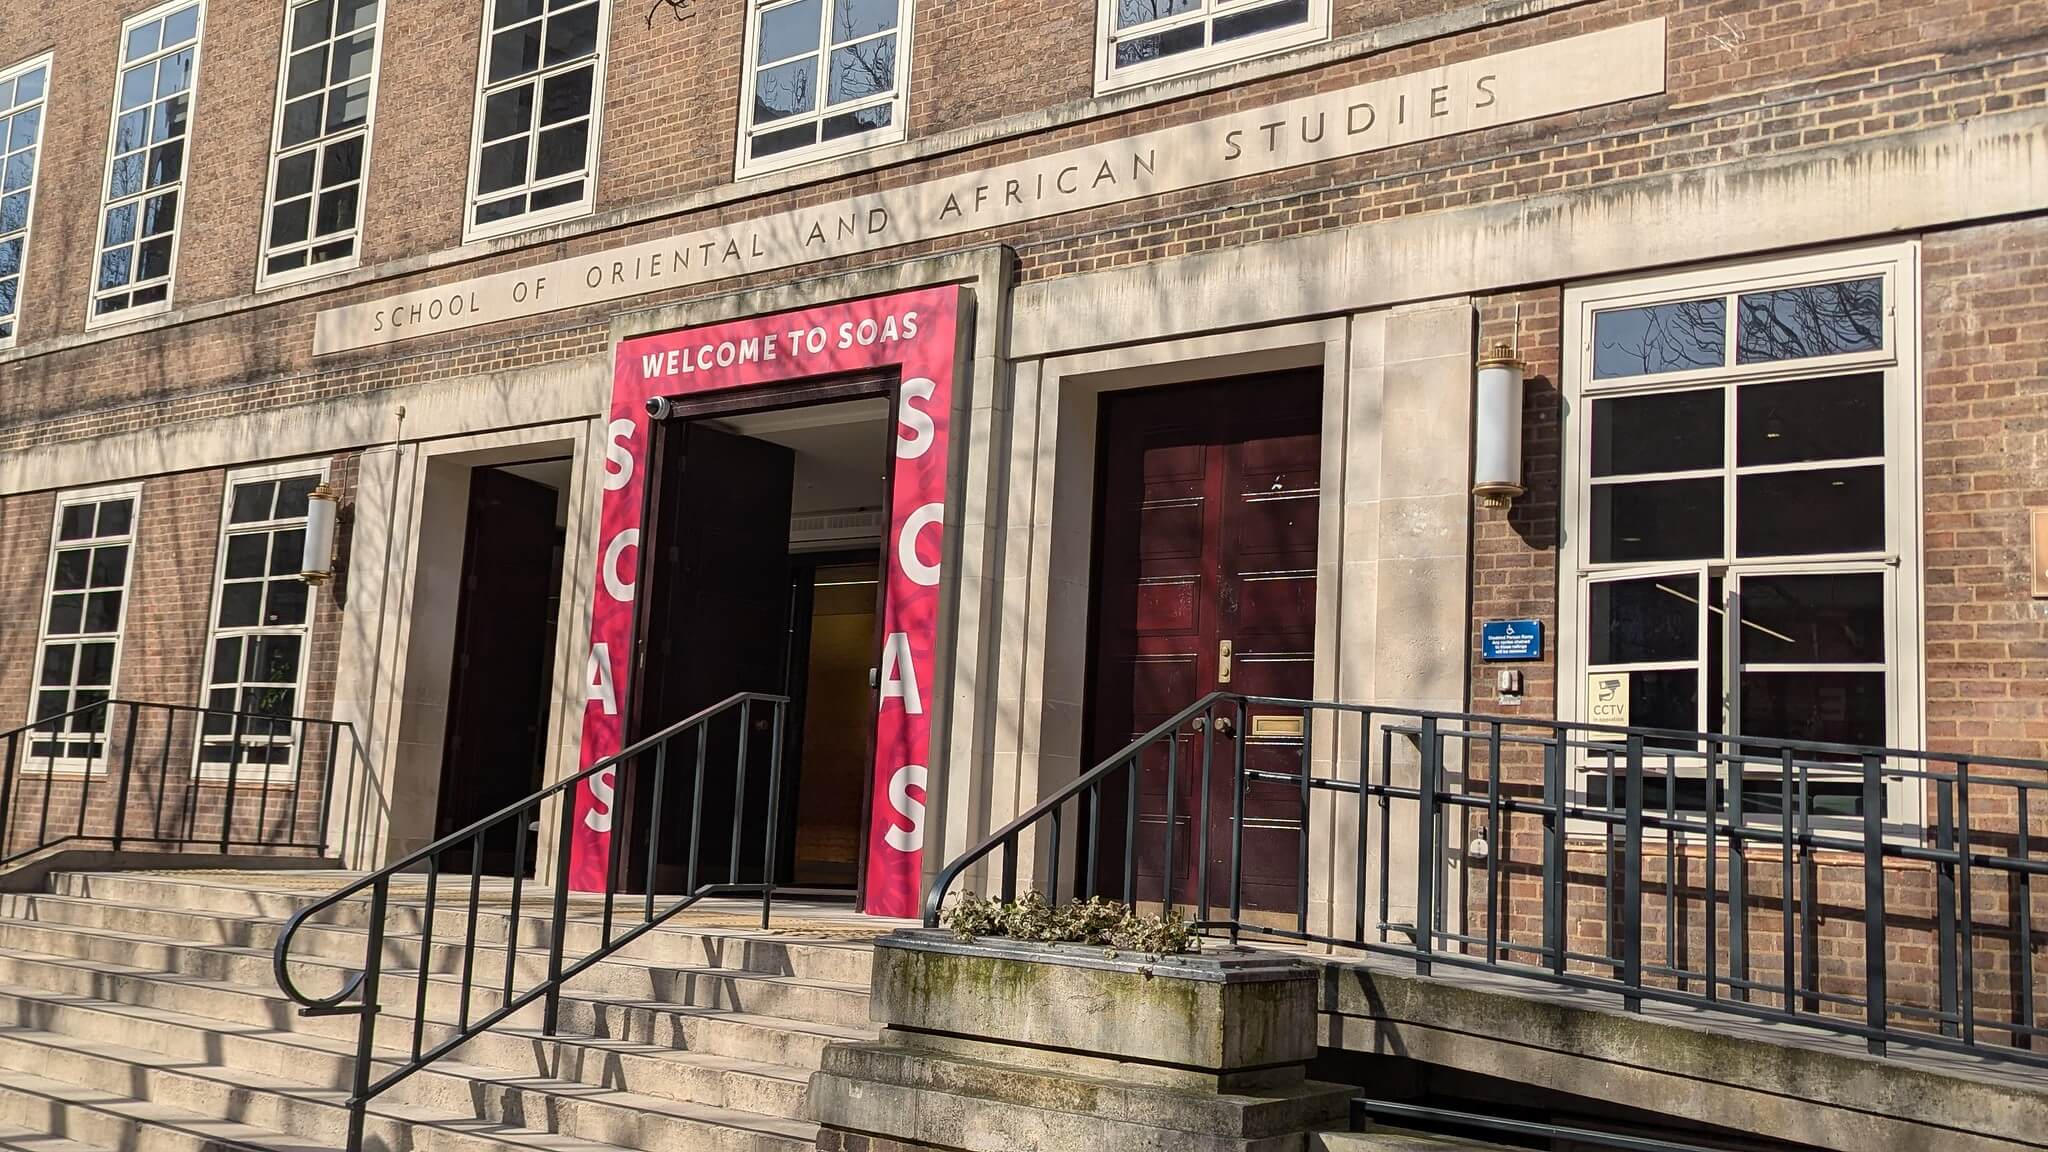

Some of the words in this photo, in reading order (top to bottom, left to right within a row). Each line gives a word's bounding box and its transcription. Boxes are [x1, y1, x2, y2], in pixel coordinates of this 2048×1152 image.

[374, 290, 480, 332] SCHOOL
[513, 277, 546, 303] OF
[586, 233, 765, 289] ORIENTAL
[805, 207, 889, 247] AND
[939, 149, 1157, 220] AFRICAN
[1224, 75, 1496, 161] STUDIES
[641, 334, 777, 379] WELCOME
[787, 327, 828, 354] TO
[838, 311, 919, 350] SOAS
[1593, 704, 1624, 715] CCTV
